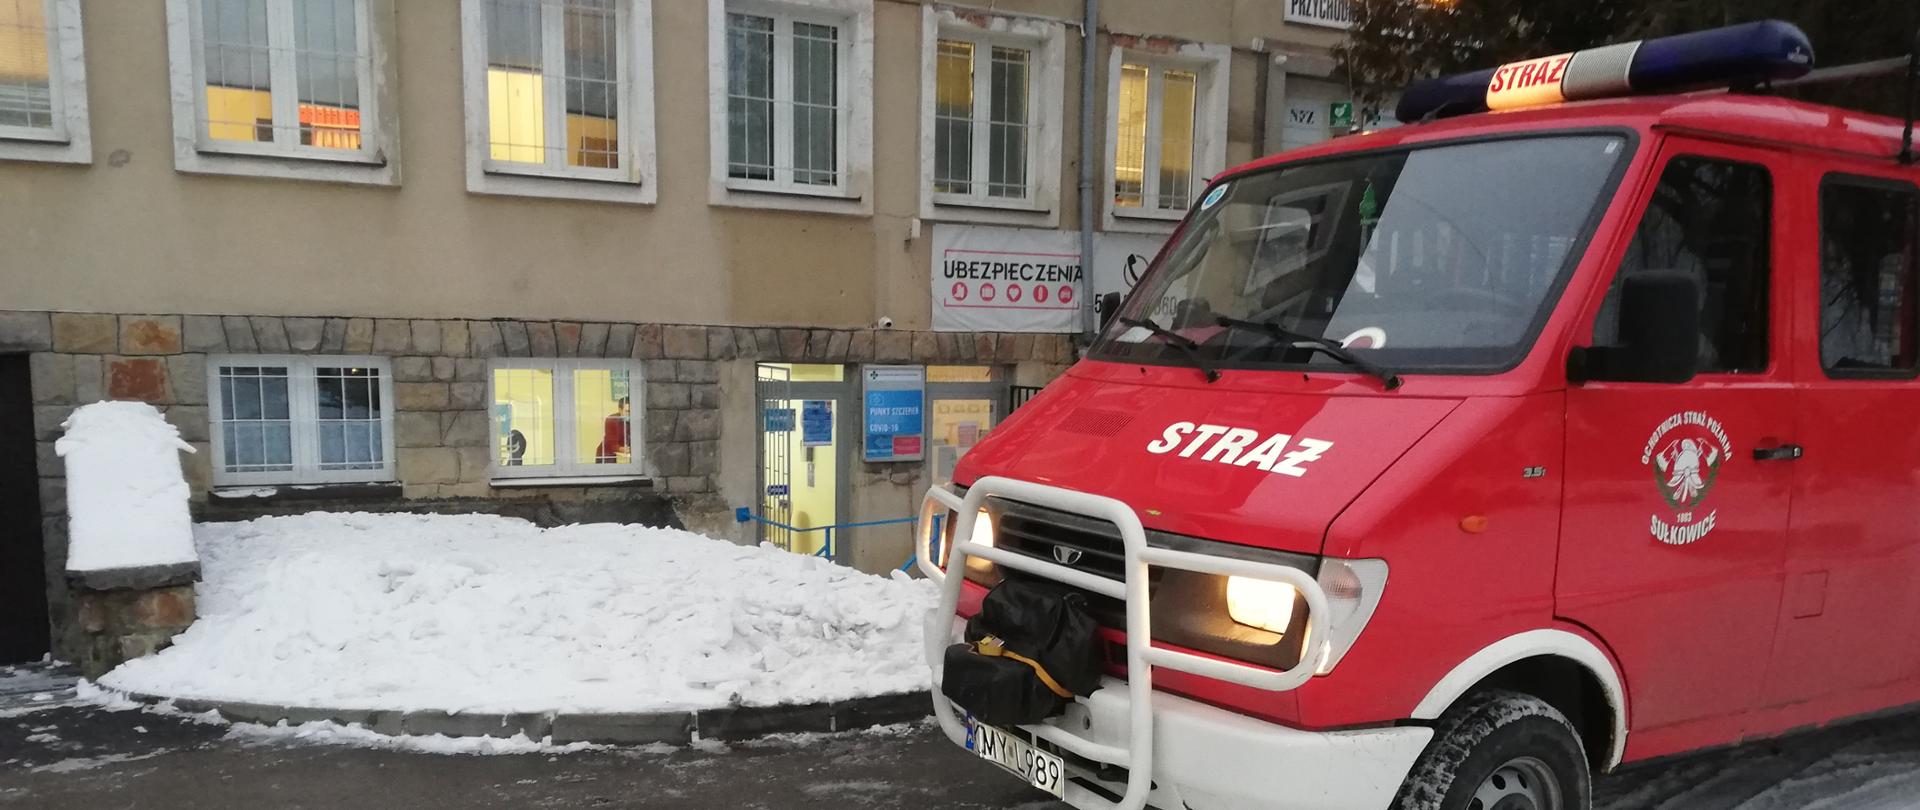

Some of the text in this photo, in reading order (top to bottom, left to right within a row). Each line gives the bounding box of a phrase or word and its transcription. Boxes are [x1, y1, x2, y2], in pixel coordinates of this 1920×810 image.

[944, 259, 1083, 283] UBEZPIECZENIA
[869, 407, 890, 416] PUNKT
[1641, 410, 1732, 465] OCHOTNICZA STRAŻ POŻARNA
[1650, 509, 1717, 545] SUŁKOWICE
[1015, 741, 1059, 790] L989
